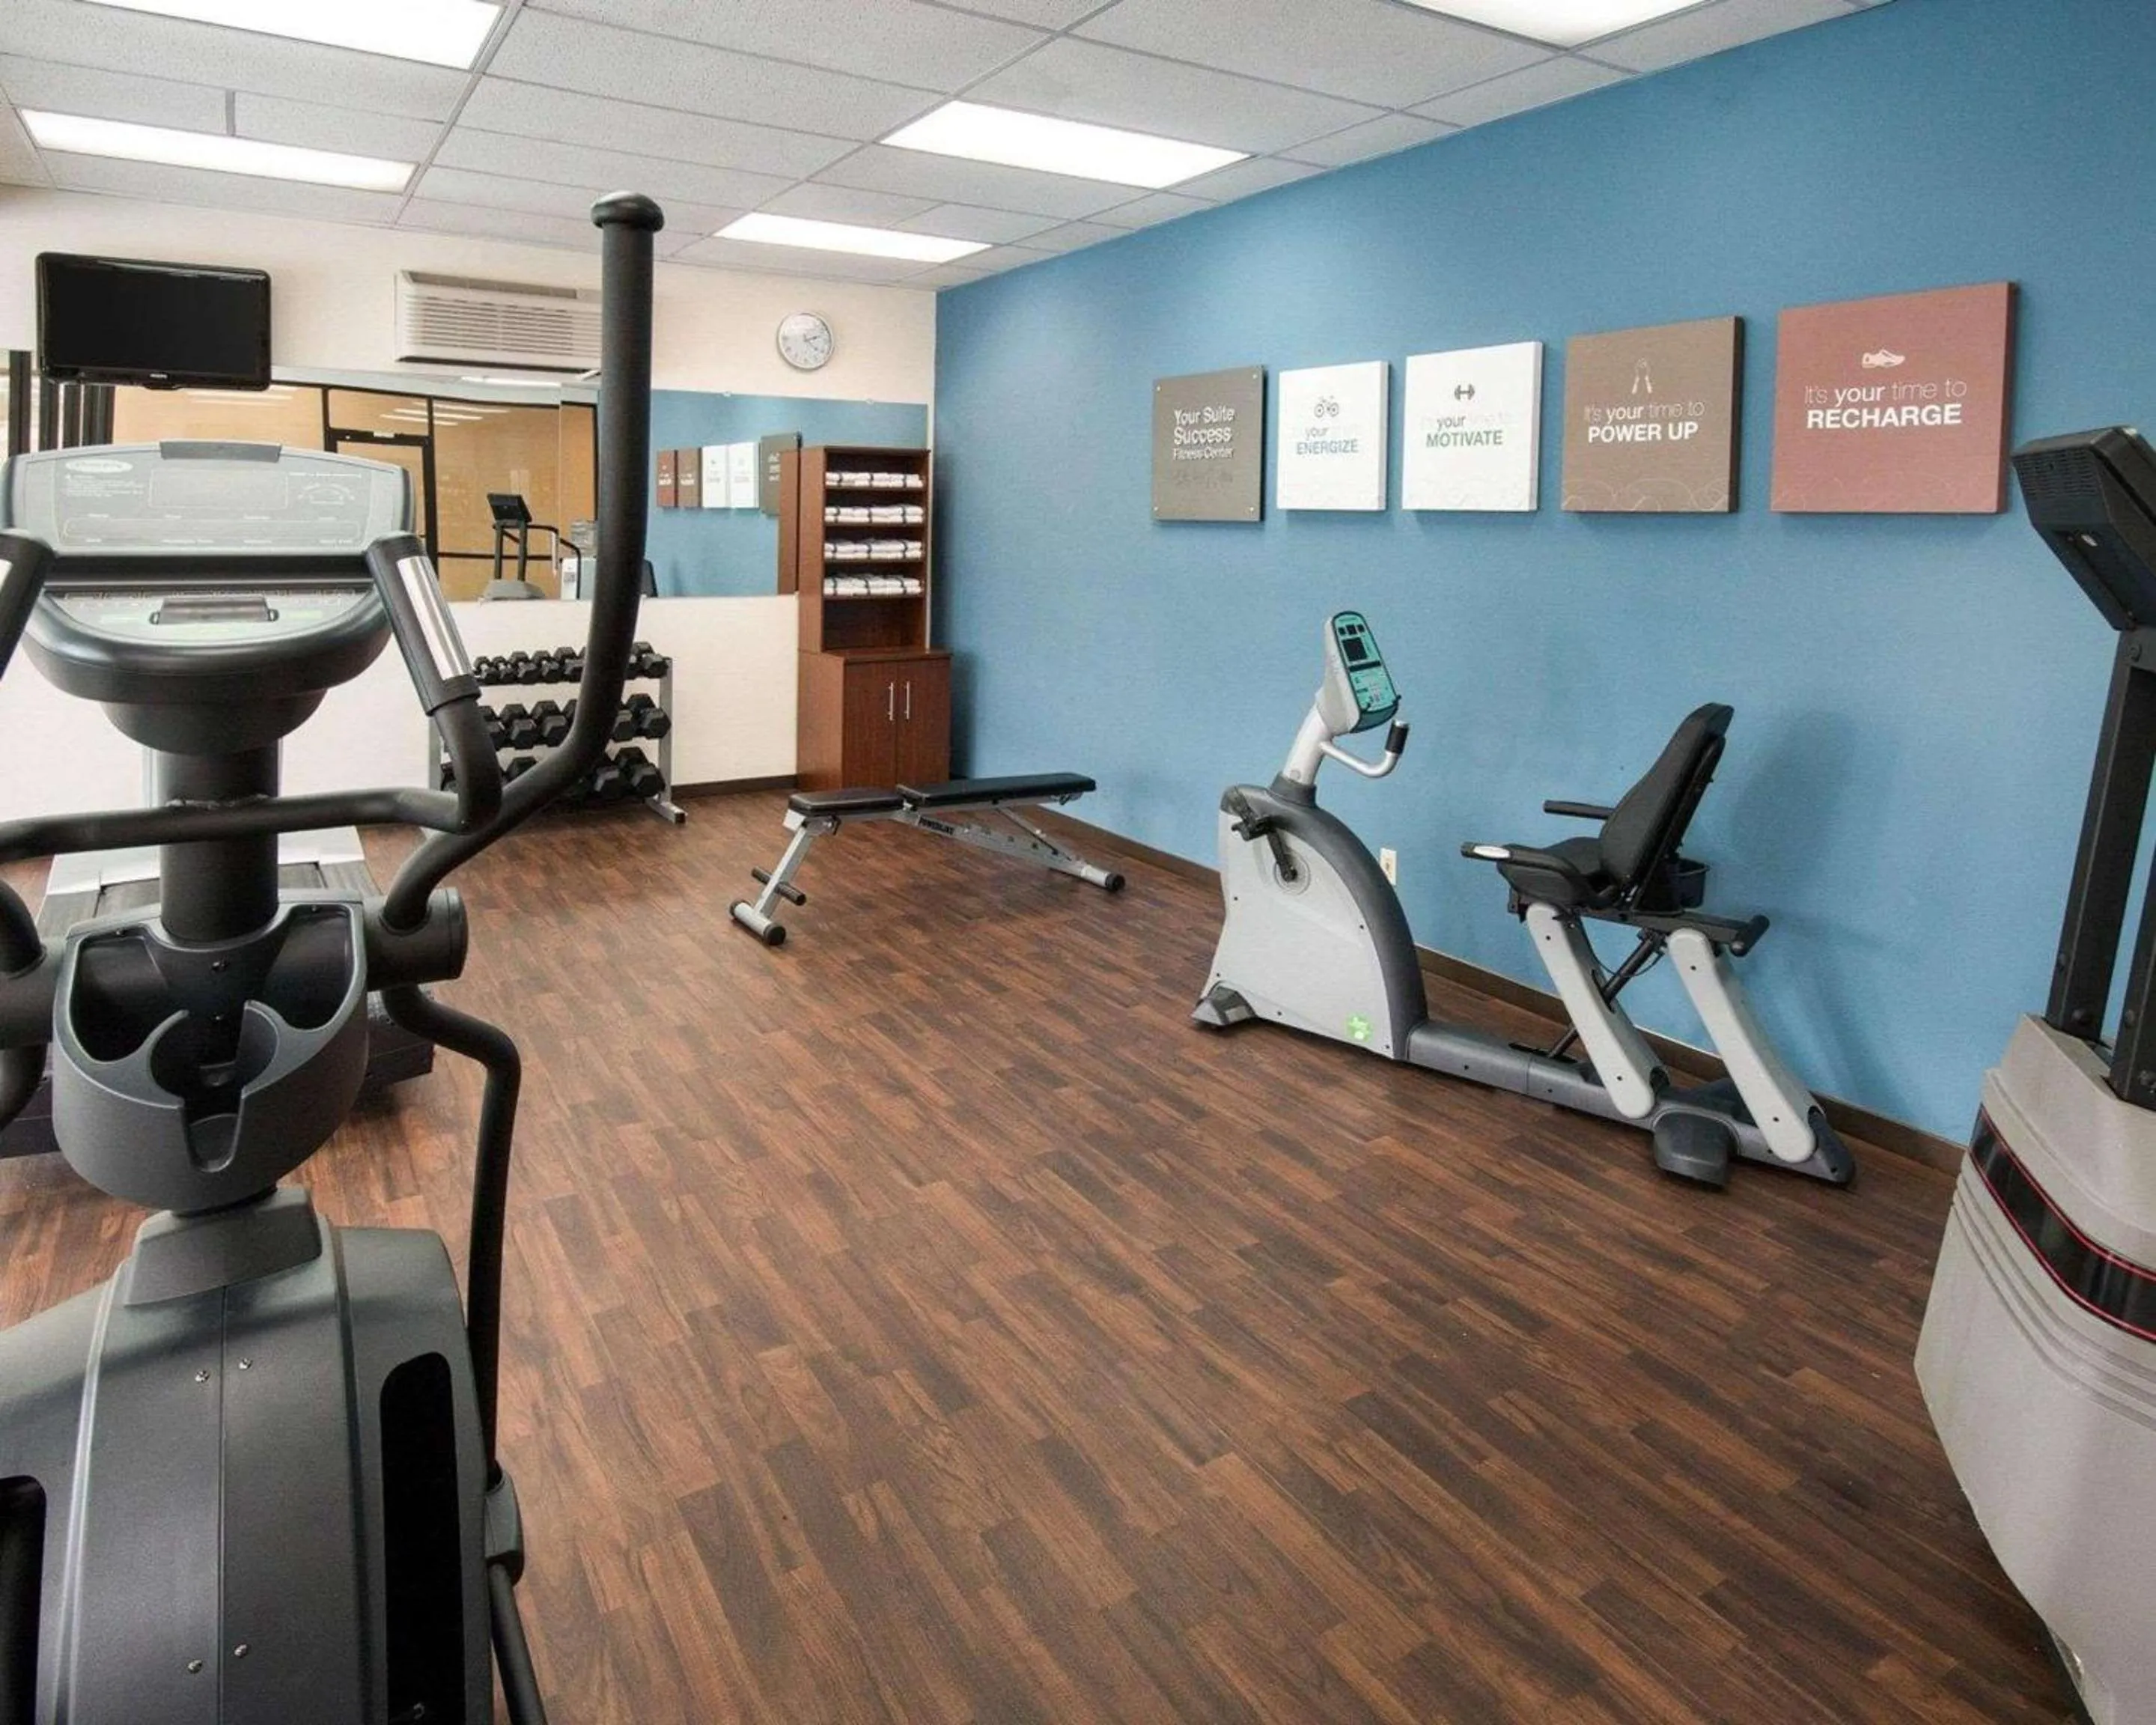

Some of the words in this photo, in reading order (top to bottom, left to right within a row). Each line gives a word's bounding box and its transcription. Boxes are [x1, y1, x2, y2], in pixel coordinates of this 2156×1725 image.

[1835, 385, 1886, 407] your
[1891, 380, 1938, 401] time
[1944, 378, 1968, 398] to
[1173, 409, 1201, 426] Your
[1203, 405, 1236, 424] Suite
[1607, 406, 1645, 425] your
[1688, 401, 1706, 416] to
[1806, 403, 1963, 429] RECHARGE
[1437, 416, 1466, 431] your
[1588, 423, 1663, 443] POWER
[1668, 421, 1699, 440] UP
[1173, 425, 1232, 445] Success
[1305, 427, 1329, 441] your
[1426, 430, 1503, 448] MOTIVATE
[1296, 439, 1359, 455] ENERGIZE
